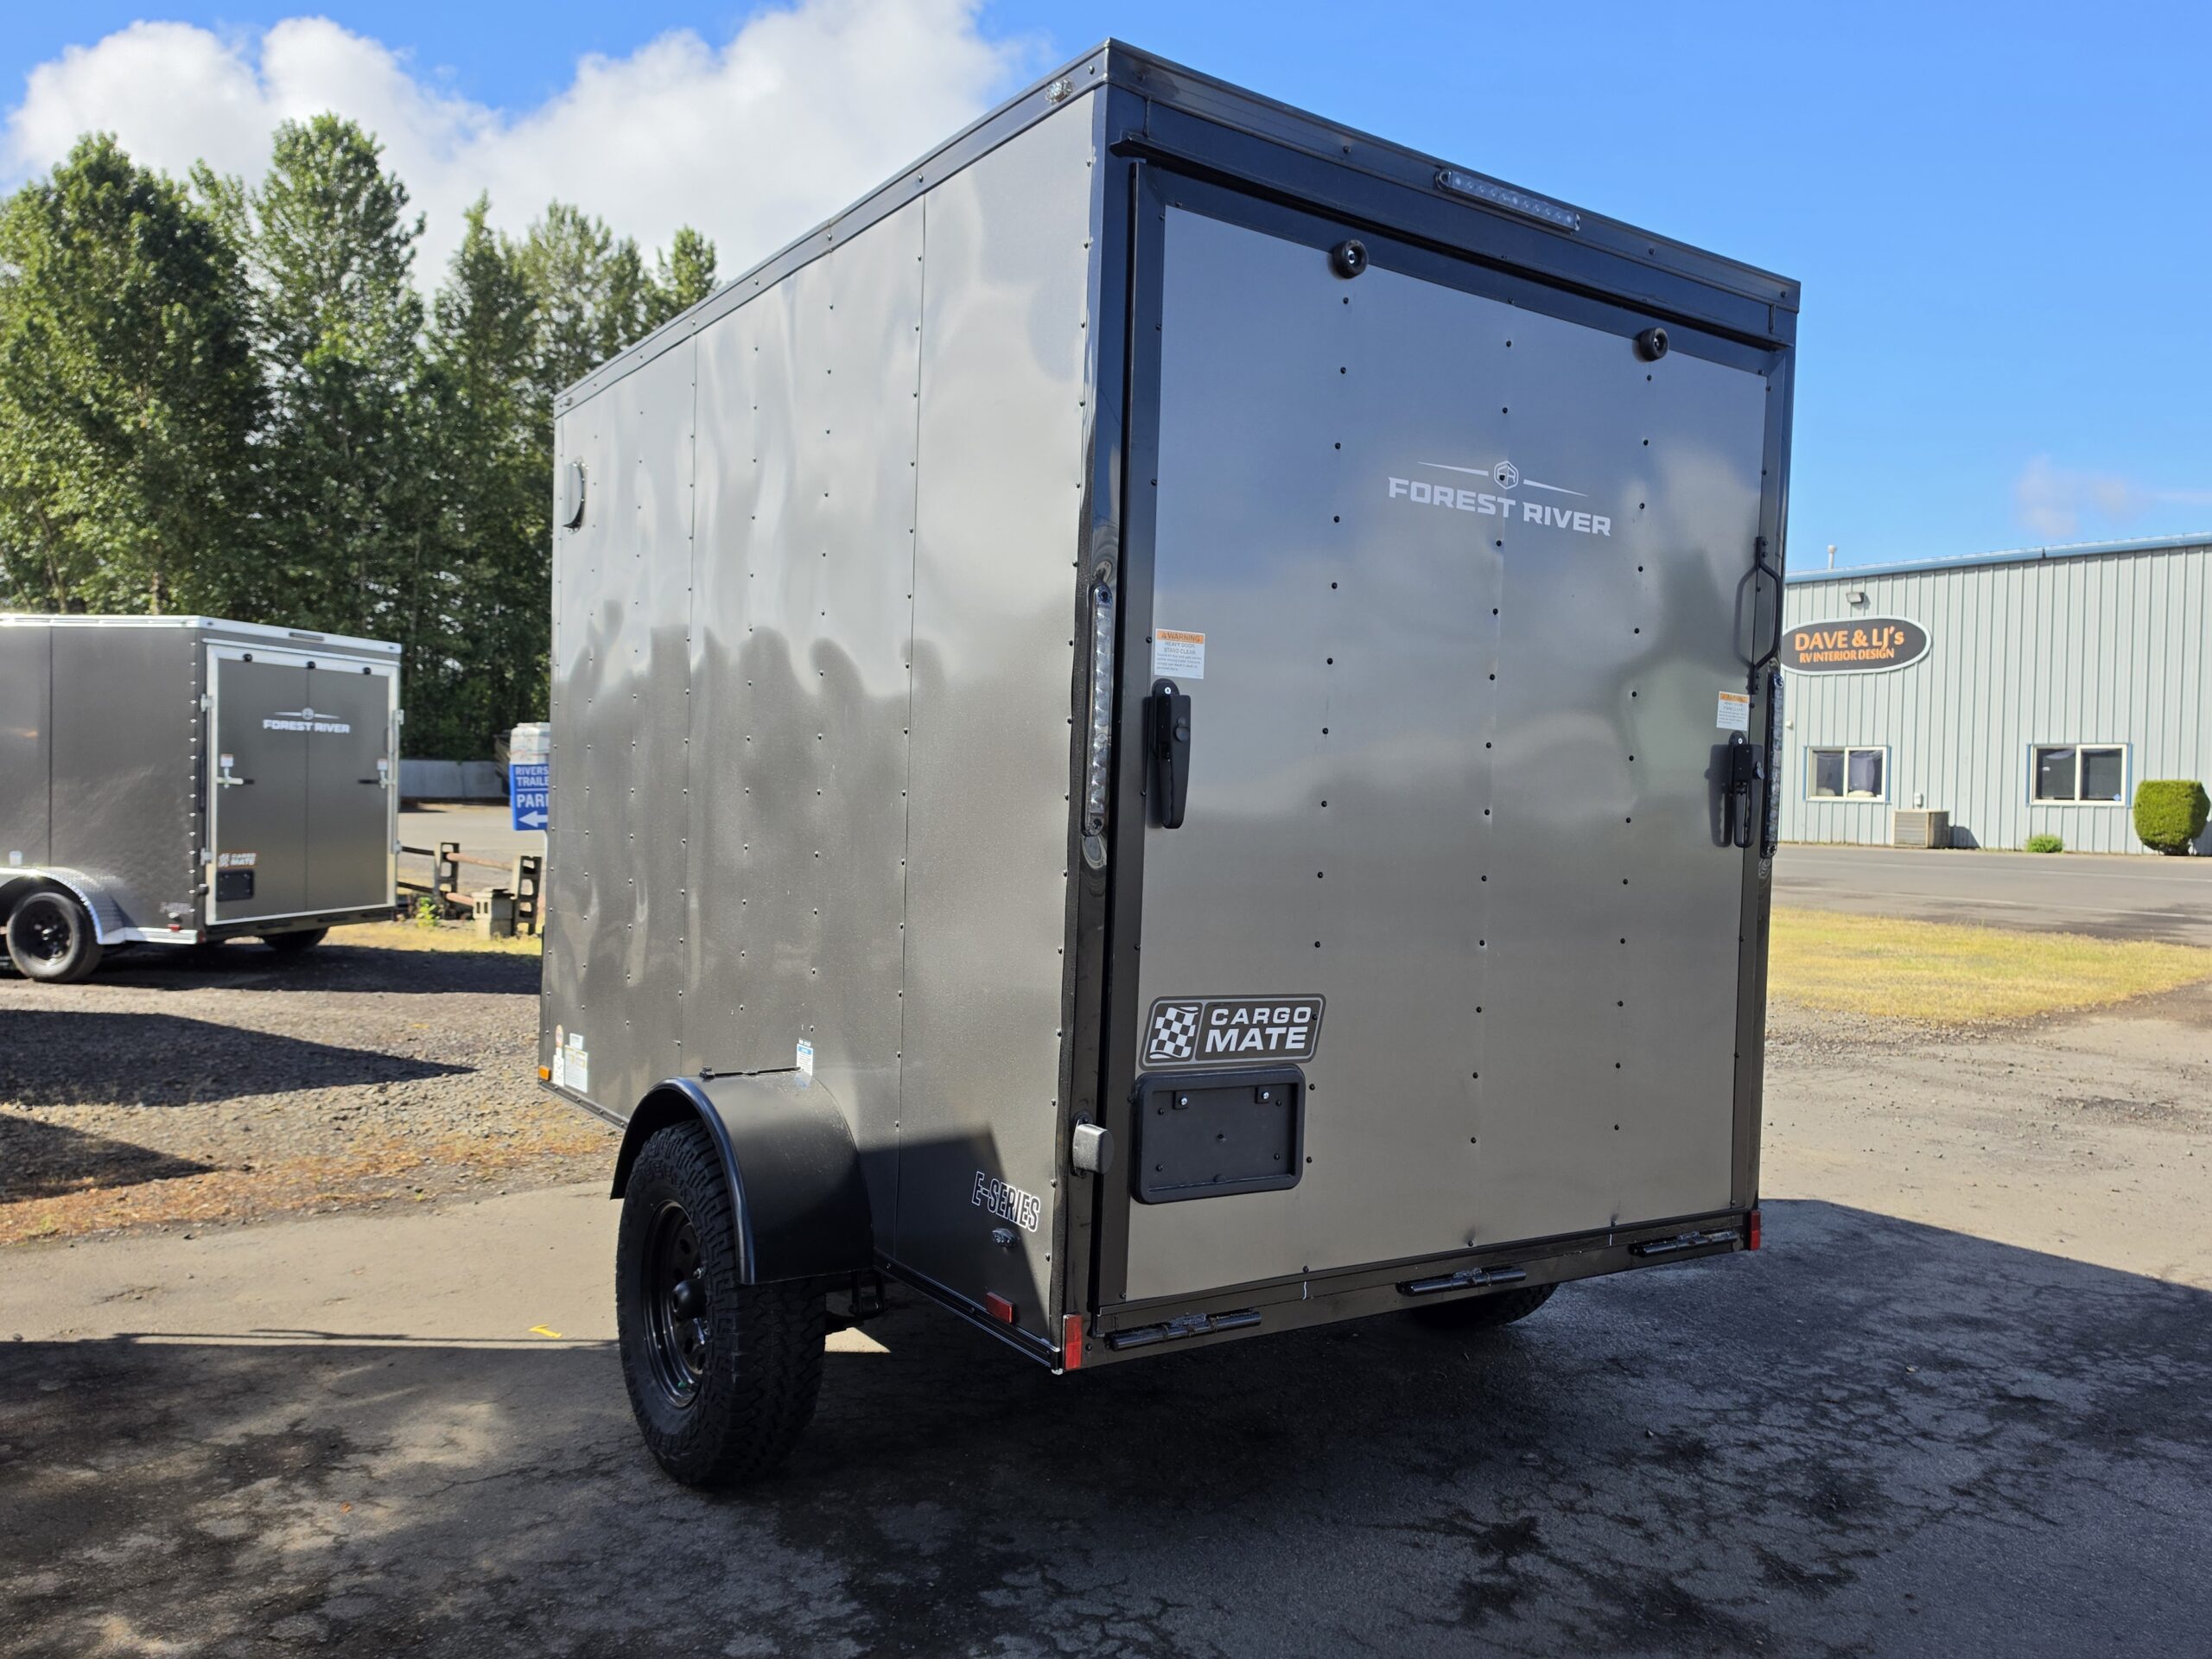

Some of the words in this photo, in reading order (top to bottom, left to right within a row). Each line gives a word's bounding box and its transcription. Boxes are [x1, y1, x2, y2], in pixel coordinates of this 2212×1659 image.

[1389, 477, 1516, 518] FOREST
[1522, 501, 1611, 537] RIVER
[1166, 632, 1200, 642] WARNING
[1796, 630, 1848, 651] DAVE
[1852, 629, 1869, 648] &
[1799, 652, 1813, 664] RV
[1813, 650, 1857, 663] INTERIOR
[1858, 647, 1895, 660] DESIGN
[263, 719, 313, 731] FOREST
[314, 722, 350, 734] RIVER
[1211, 1007, 1312, 1026] CARGO
[1205, 1027, 1308, 1052] MATE
[971, 1171, 1040, 1232] E-SERIES
